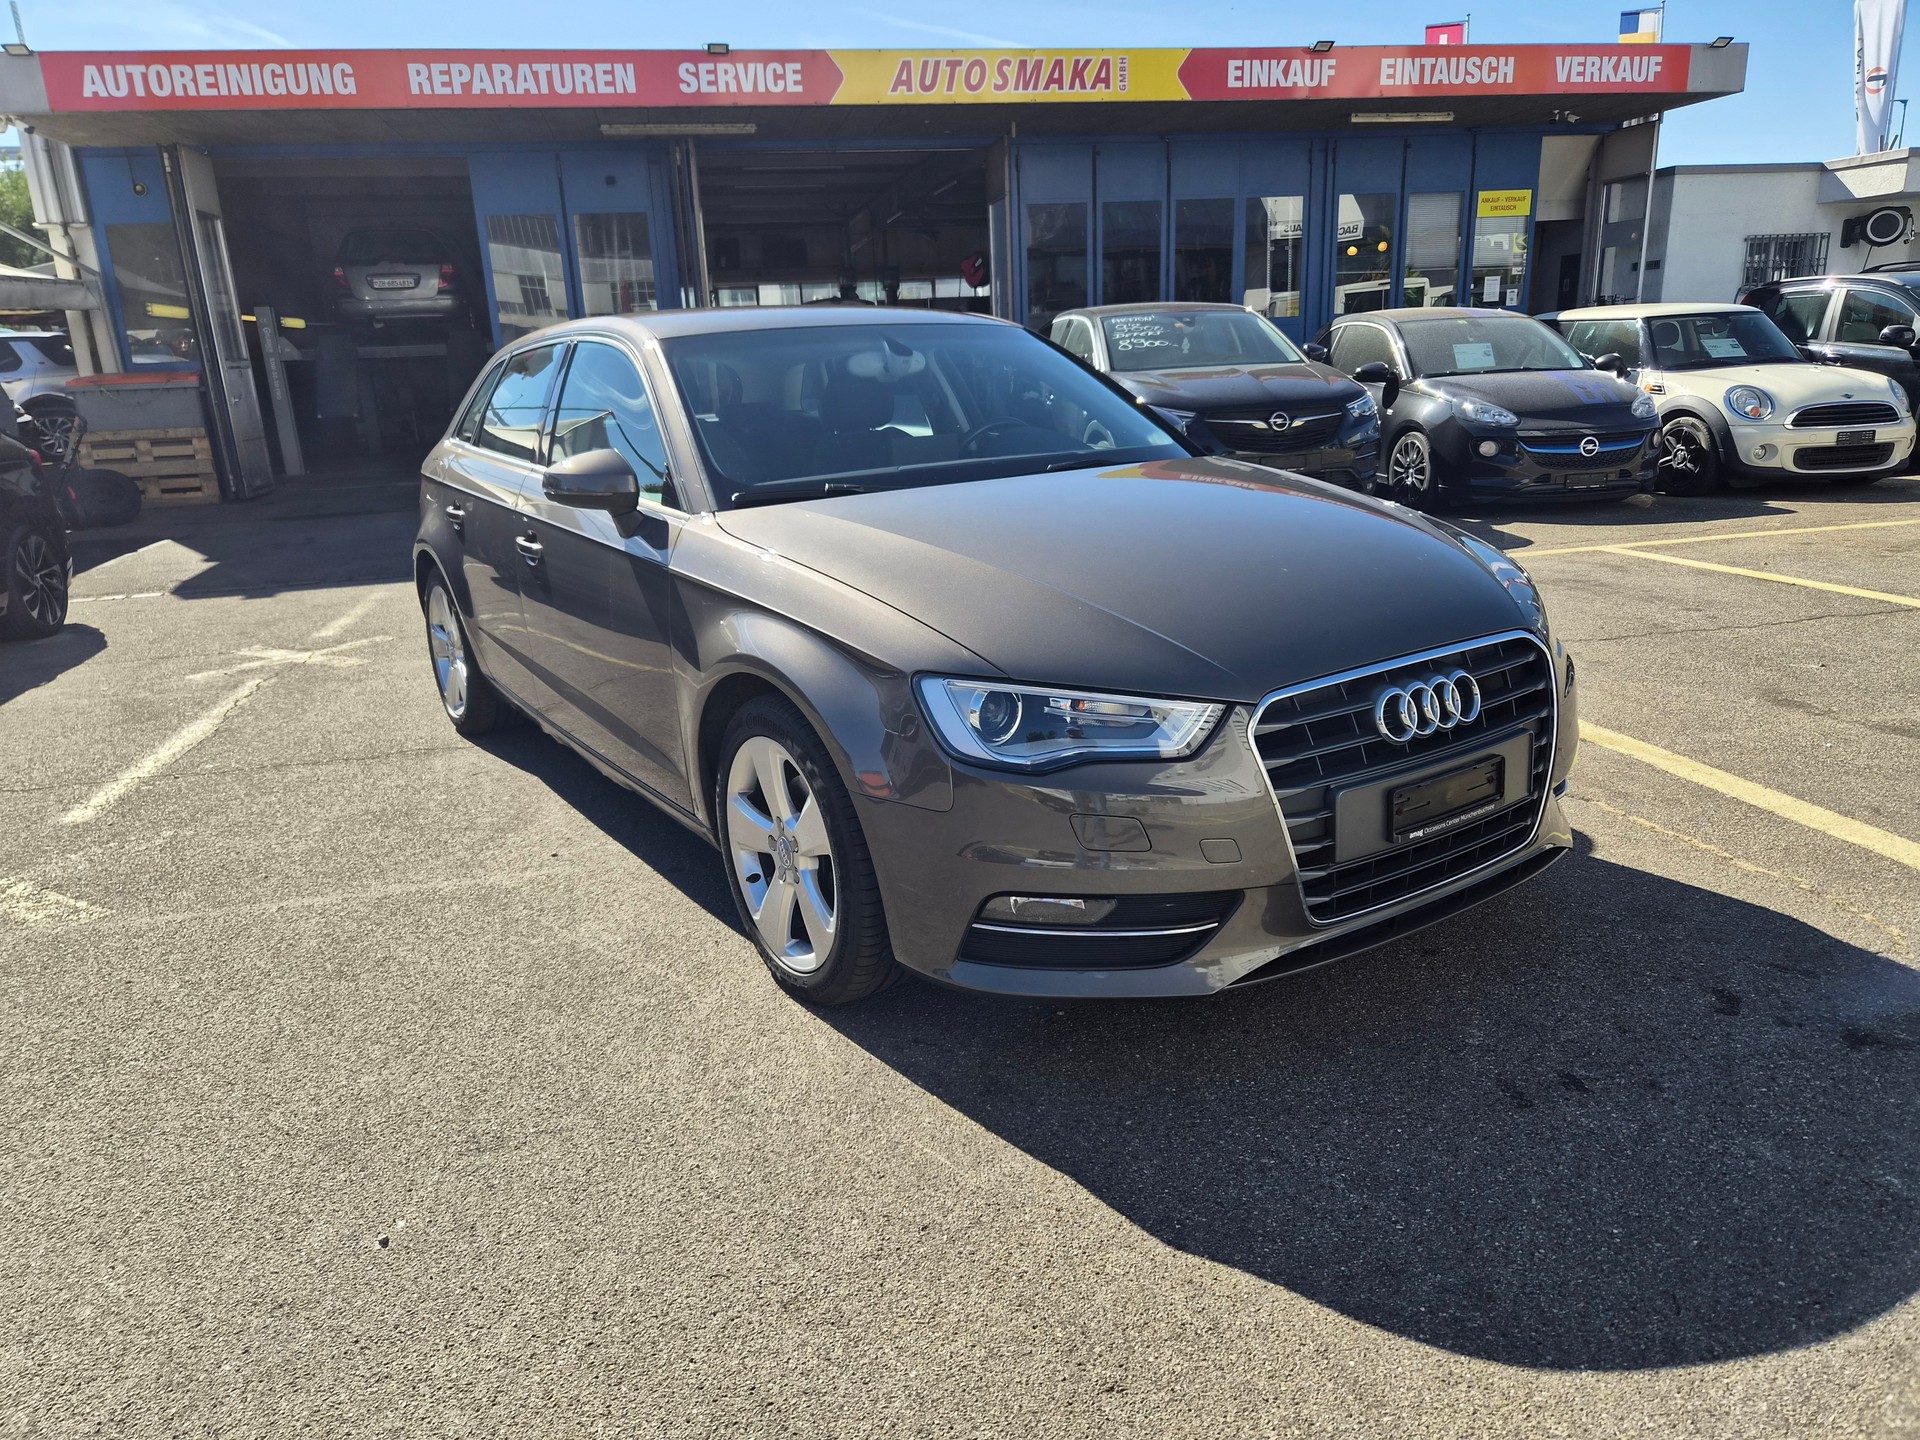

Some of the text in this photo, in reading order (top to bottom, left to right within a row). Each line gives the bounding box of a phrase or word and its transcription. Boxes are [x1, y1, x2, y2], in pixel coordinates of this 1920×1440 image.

[82, 62, 803, 97] AUTOREINIGUNG REPARATUREN SERVICE
[890, 56, 1128, 95] AUTO SMAKA GMBH
[1227, 56, 1663, 88] EINKAUF EINTAUSCH VERKAUF
[1504, 195, 1528, 203] VERKAUF
[1409, 829, 1423, 839] amag
[1424, 822, 1447, 834] Occasions
[1446, 817, 1460, 827] Center
